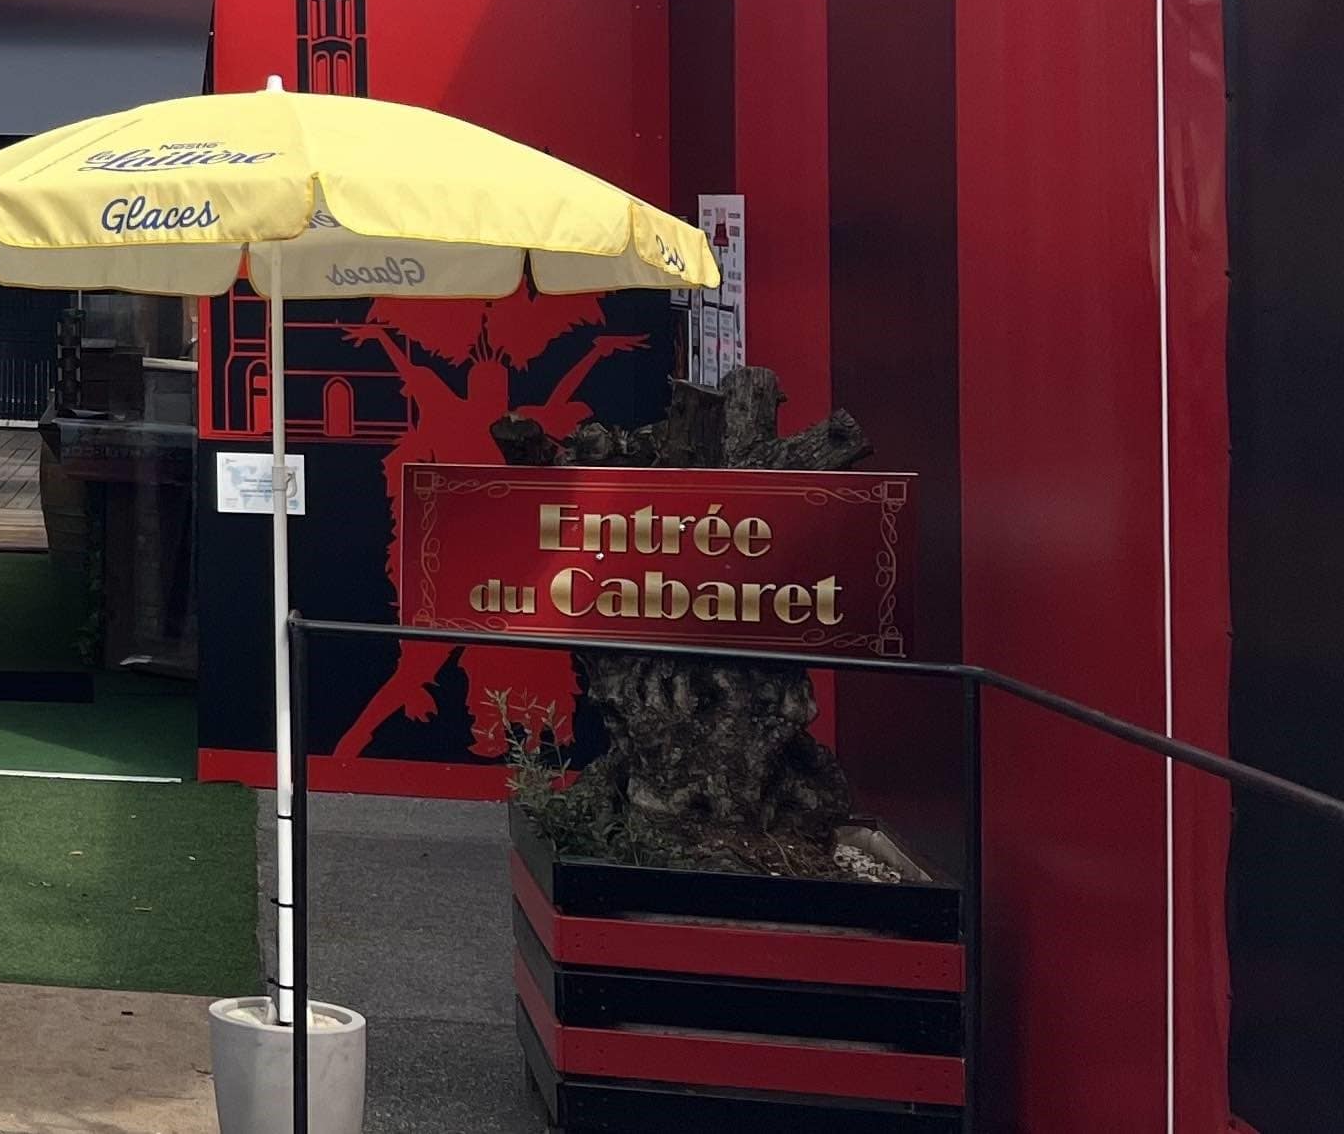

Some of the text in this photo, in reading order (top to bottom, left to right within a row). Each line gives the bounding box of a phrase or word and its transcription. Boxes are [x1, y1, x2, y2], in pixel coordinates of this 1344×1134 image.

[101, 195, 220, 234] Glaces
[539, 503, 772, 558] Entrée
[469, 567, 844, 626] du Cabaret
